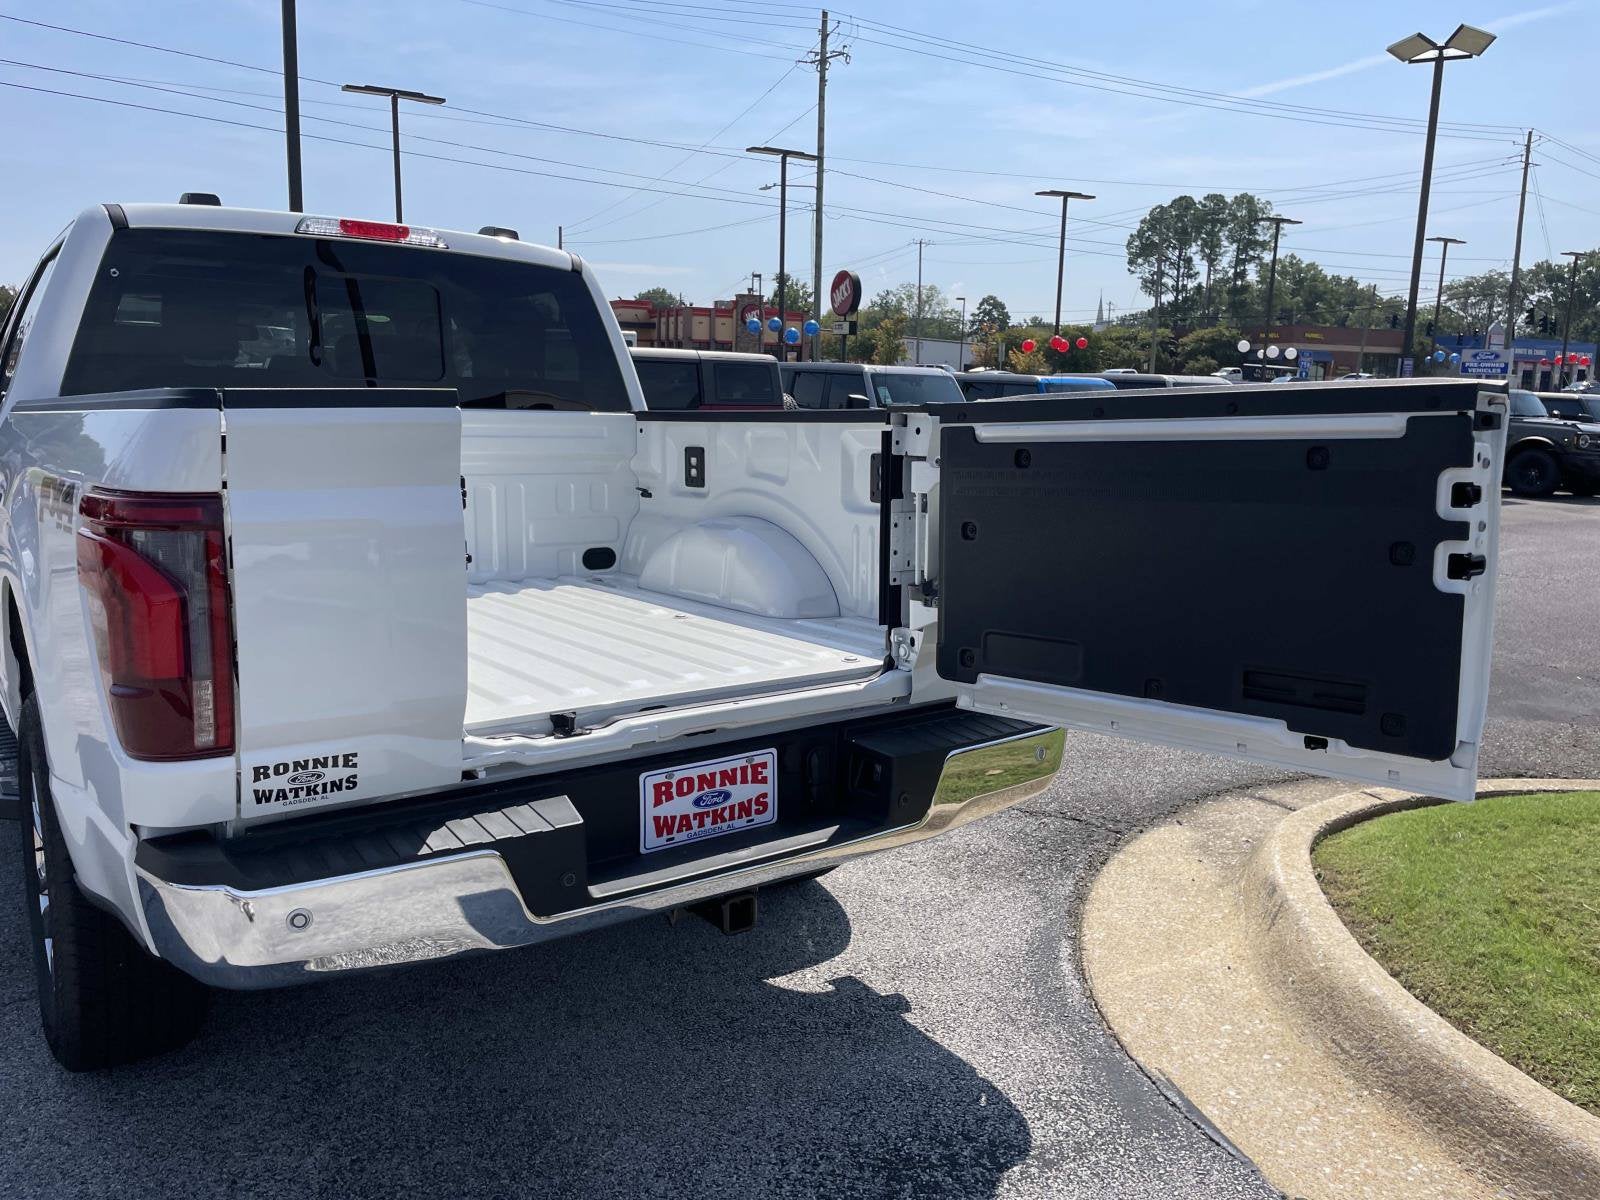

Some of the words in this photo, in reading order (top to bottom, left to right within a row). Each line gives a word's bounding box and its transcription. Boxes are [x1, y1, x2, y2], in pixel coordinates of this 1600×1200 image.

[252, 752, 358, 783] RONNIE
[253, 774, 358, 804] WATKINS
[653, 761, 768, 808] RONNIE
[699, 792, 724, 806] Ford
[653, 792, 769, 839] WATKINS
[726, 823, 736, 831] AL
